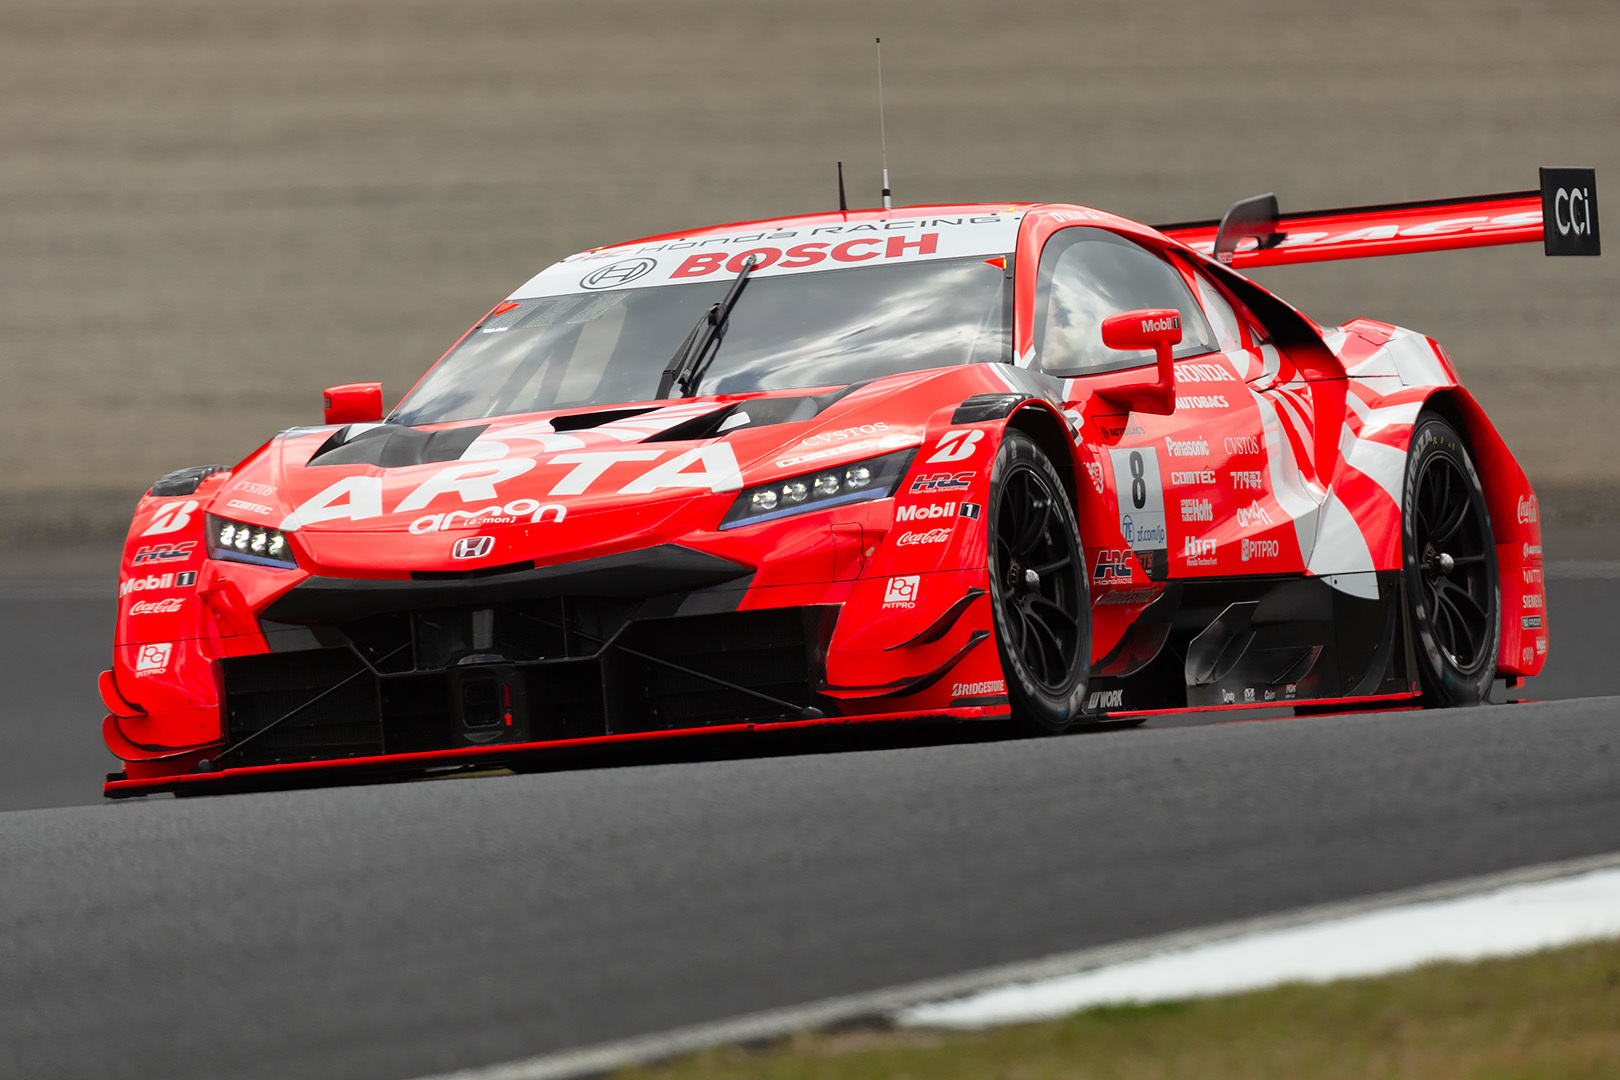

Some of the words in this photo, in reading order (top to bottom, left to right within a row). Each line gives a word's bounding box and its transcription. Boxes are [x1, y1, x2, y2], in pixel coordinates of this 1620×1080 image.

[636, 229, 797, 255] Honda
[811, 215, 1001, 236] RACING
[668, 232, 939, 279] BOSCH
[1141, 319, 1172, 333] Mobil
[1174, 364, 1236, 383] HONDA
[1176, 396, 1229, 409] AUTOBACS
[801, 421, 889, 446] CVSTOS
[1165, 436, 1209, 457] Panasonic
[1224, 437, 1259, 455] CVSTOS
[278, 441, 744, 533] ARTA
[911, 471, 977, 490] HRC
[1129, 451, 1147, 509] 8
[1171, 471, 1216, 485] COMTEC
[227, 499, 273, 515] COMTEC
[896, 502, 956, 522] Mobil
[1193, 499, 1213, 521] Holts
[896, 528, 953, 546] Coca-Cola
[1137, 525, 1165, 544] zf.com/jp
[133, 541, 198, 564] HRC
[1250, 540, 1279, 558] PITPRO
[1093, 549, 1132, 579] HRC
[119, 574, 174, 599] Mobil
[129, 598, 187, 616] Coca-Cola
[1522, 594, 1542, 609] SIEMENS
[135, 668, 166, 678] PITPRO
[952, 680, 1004, 696] BRIDGESTONE
[1100, 689, 1123, 708] WORK
